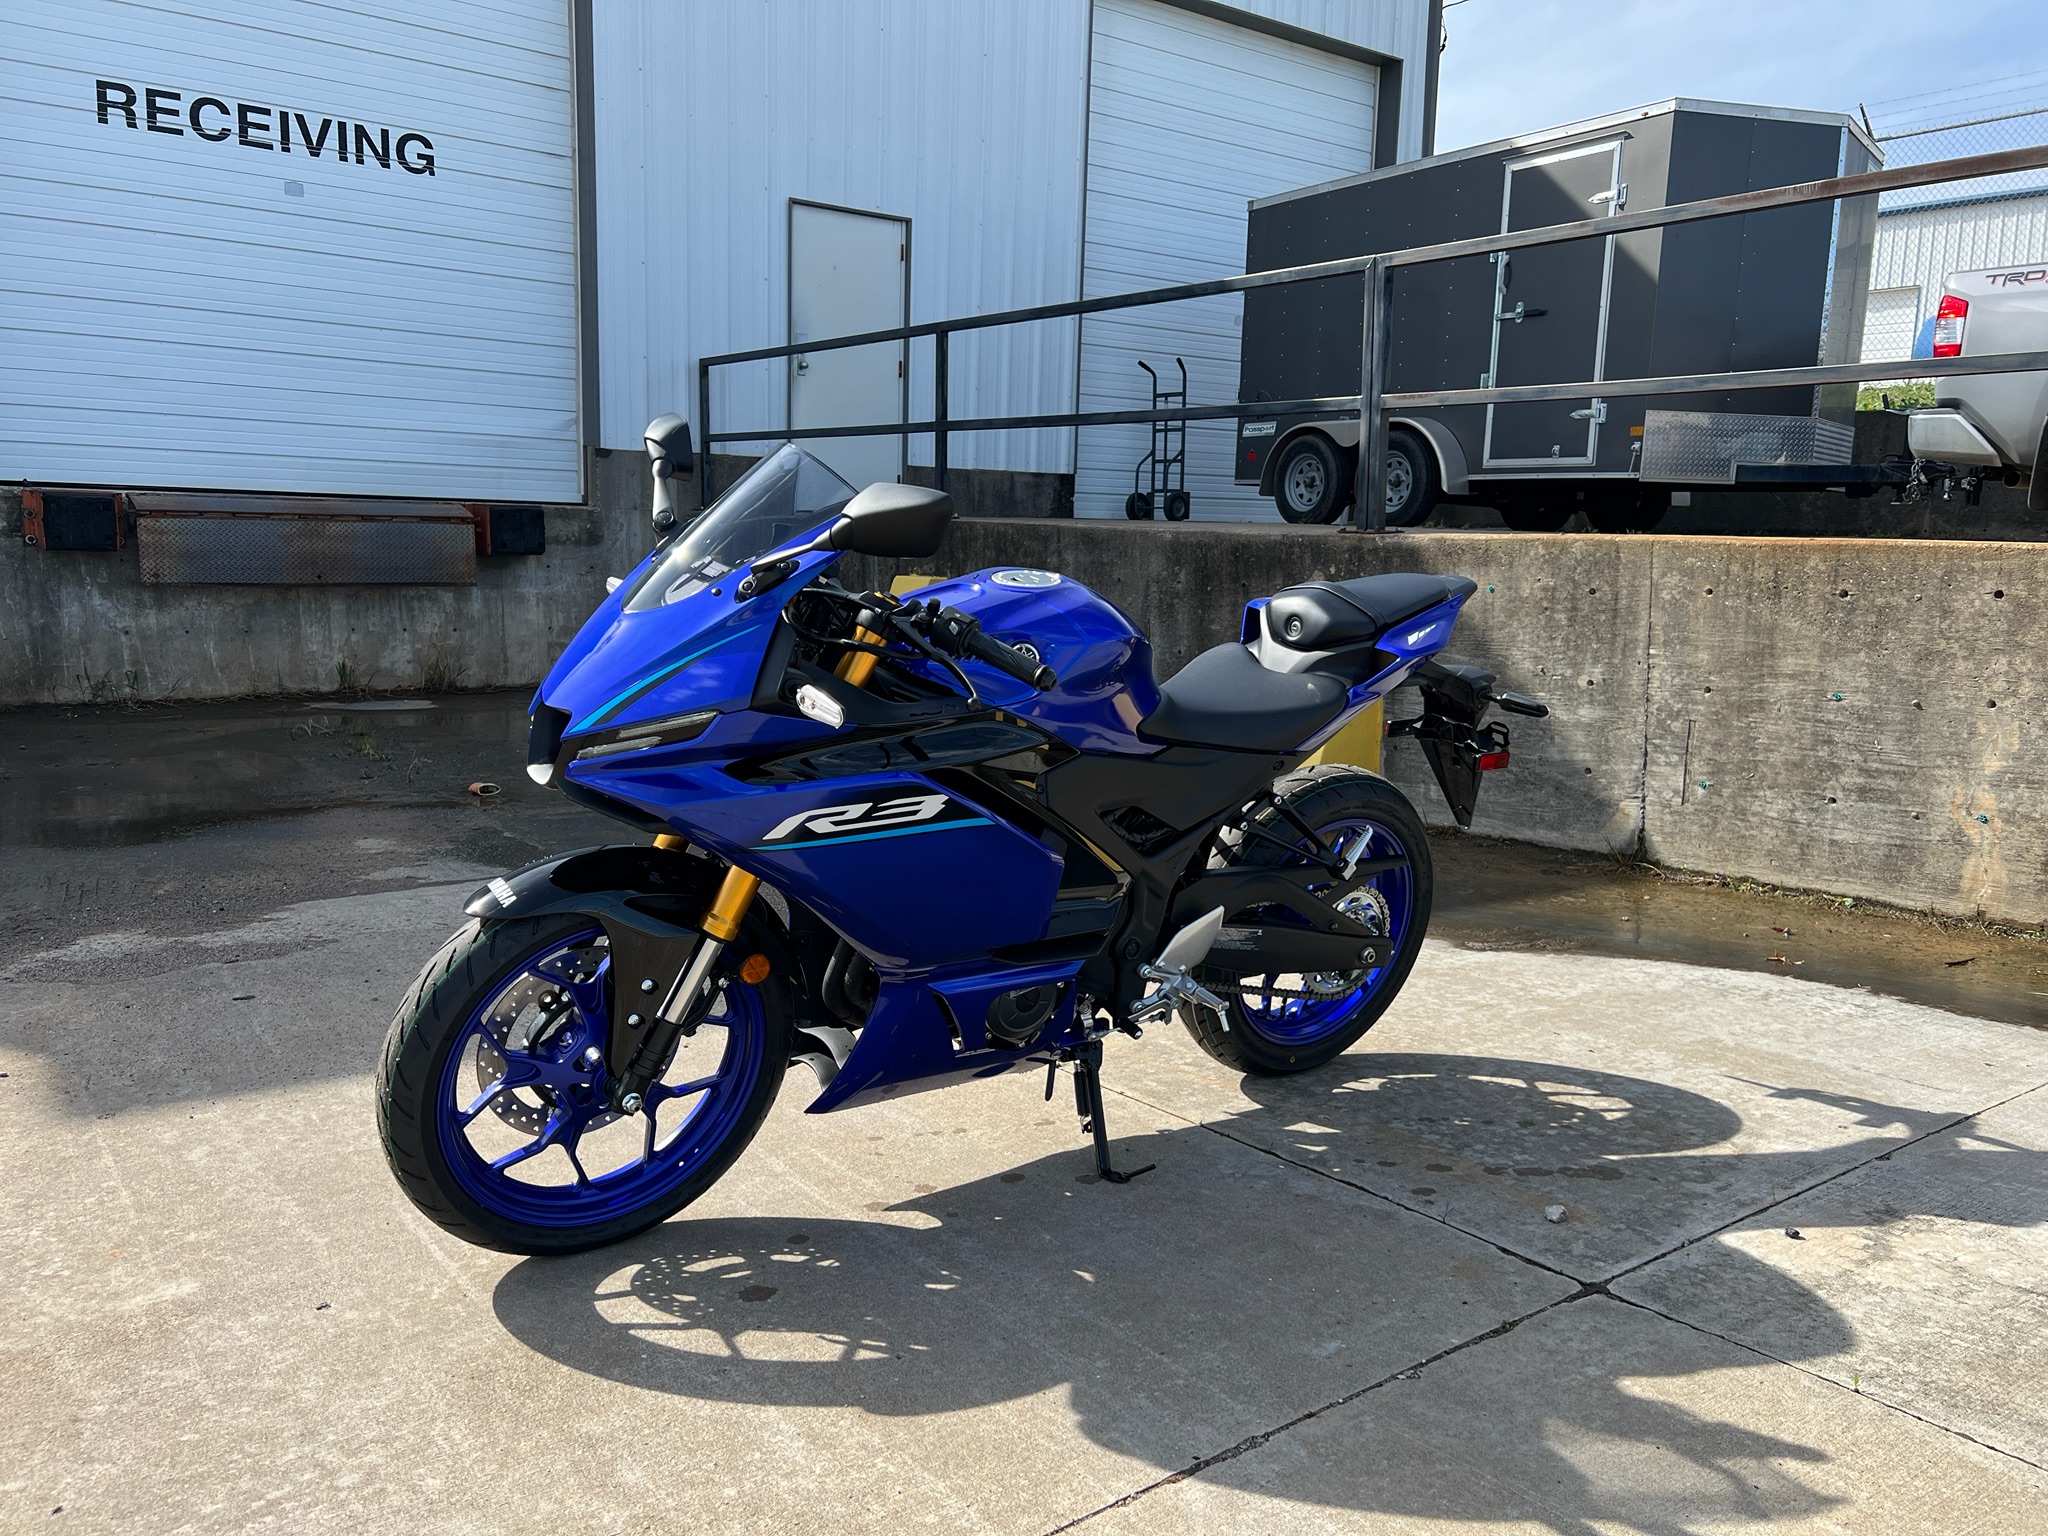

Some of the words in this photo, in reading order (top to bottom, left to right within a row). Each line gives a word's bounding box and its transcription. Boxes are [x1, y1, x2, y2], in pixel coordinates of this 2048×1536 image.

[95, 79, 436, 177] RECEIVING
[1985, 269, 2047, 287] TRD
[1244, 425, 1275, 433] Passport
[762, 794, 949, 840] R3
[486, 876, 517, 909] MAHA
